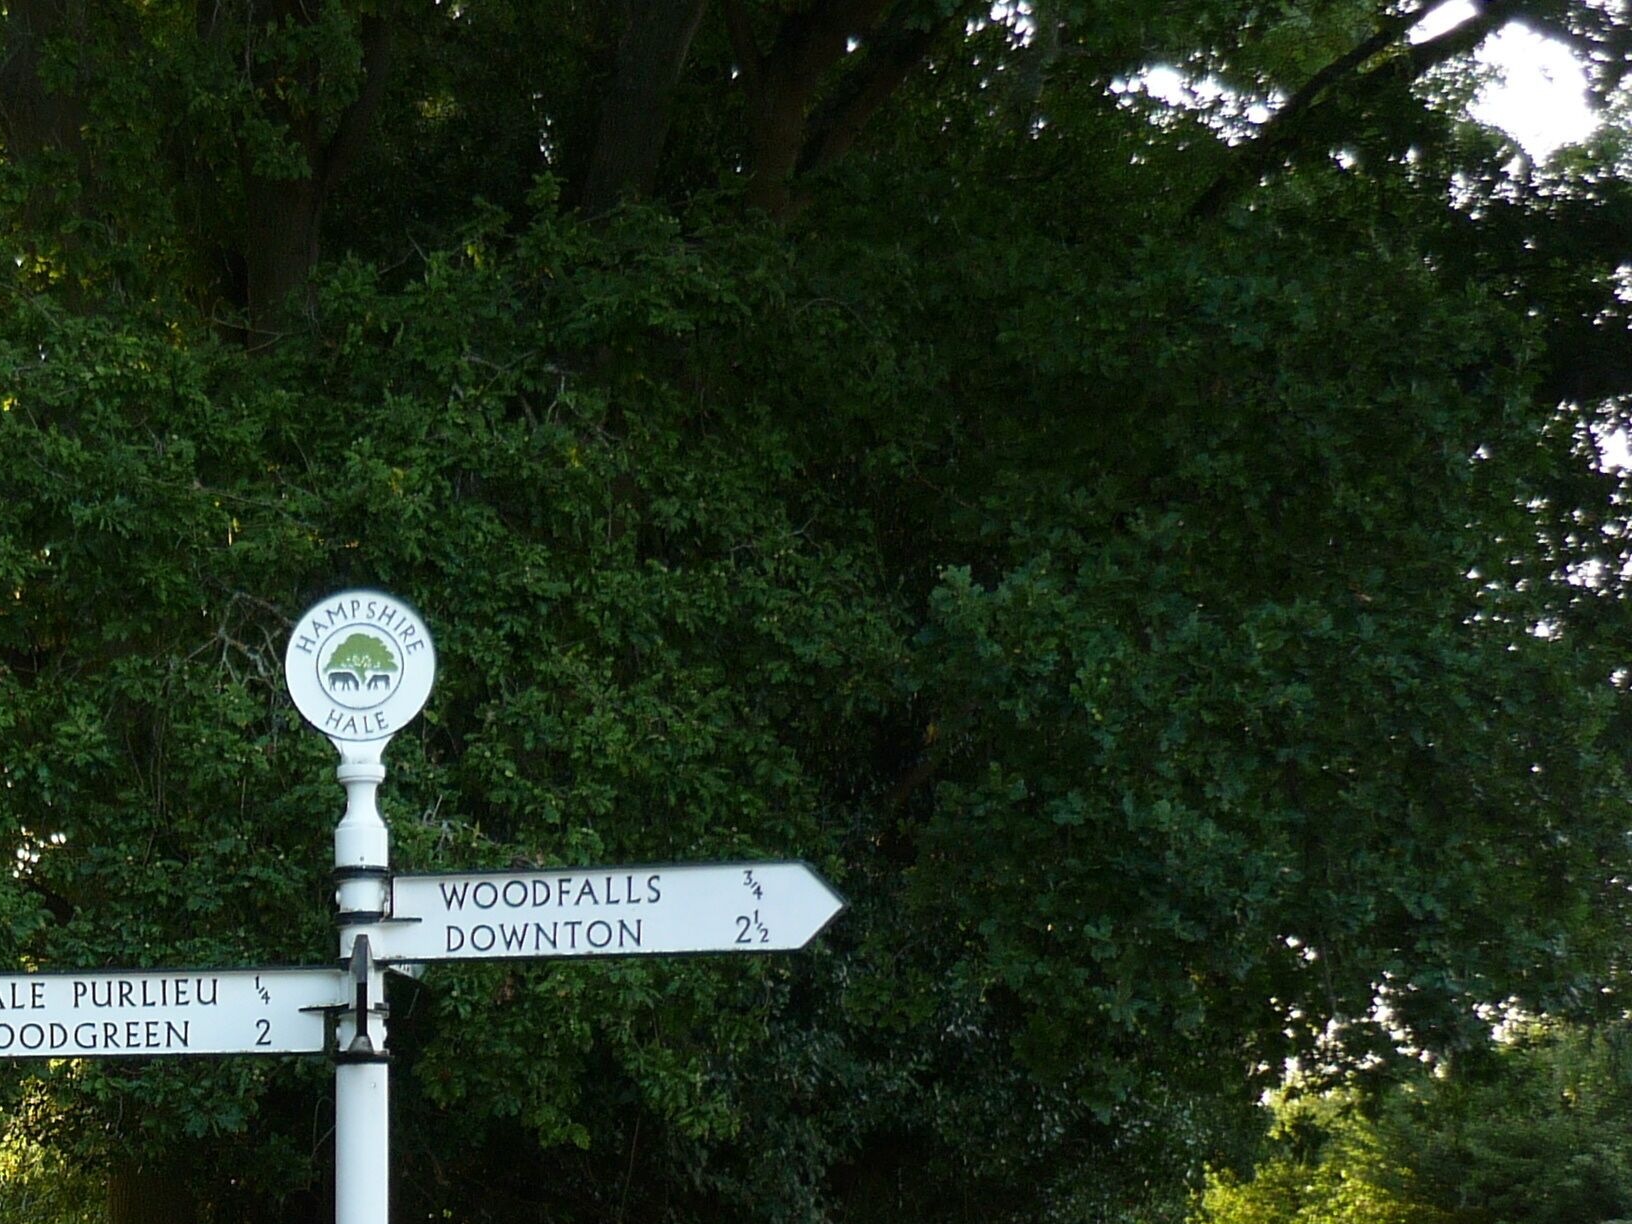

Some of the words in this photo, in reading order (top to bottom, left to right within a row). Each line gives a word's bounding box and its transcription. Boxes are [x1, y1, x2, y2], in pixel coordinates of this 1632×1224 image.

[296, 600, 425, 655] HAMPSHIRE
[325, 709, 390, 734] HALE
[439, 875, 661, 911] WOODFALLS
[446, 919, 643, 952] DOWNTON
[73, 978, 219, 1008] PURLIEU
[255, 1018, 272, 1046] 2
